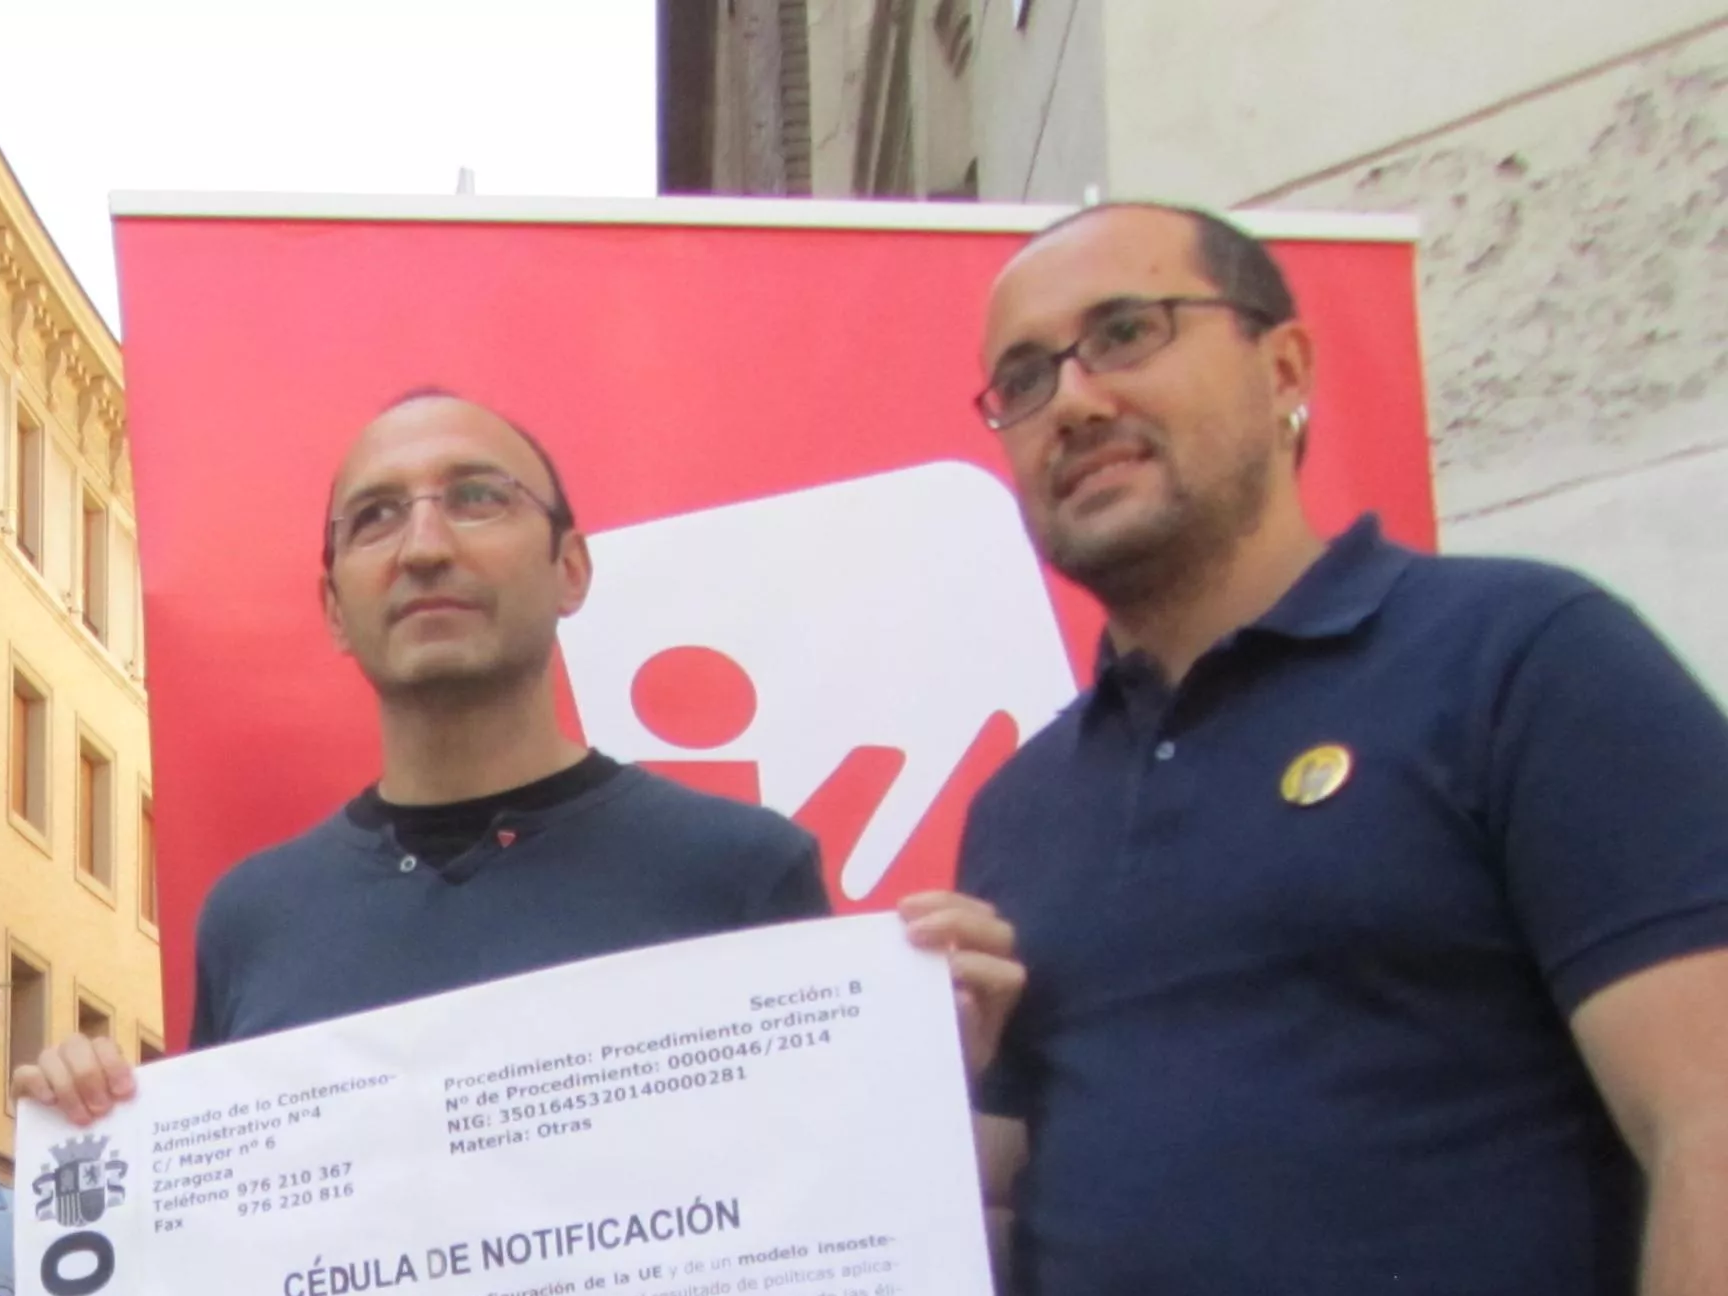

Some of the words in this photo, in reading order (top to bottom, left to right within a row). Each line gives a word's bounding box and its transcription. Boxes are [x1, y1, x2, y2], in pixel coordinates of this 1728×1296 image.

[848, 979, 862, 994] B
[600, 1022, 754, 1059] Procedimiento
[759, 1005, 860, 1031] ordinario
[474, 1090, 501, 1106] de
[666, 1029, 832, 1069] 0000046/2014
[151, 1109, 222, 1135] Juzgado
[226, 1103, 250, 1117] de
[254, 1099, 272, 1112] lo
[152, 1117, 280, 1152] Administrativo
[536, 1118, 592, 1138] Otras
[152, 1157, 172, 1173] C/
[177, 1147, 236, 1166] Mayor
[263, 1135, 277, 1149] 6
[152, 1168, 233, 1193] Zaragoza
[152, 1189, 230, 1211] Teléfono
[236, 1177, 272, 1196] 976
[278, 1169, 312, 1189] 210
[318, 1161, 352, 1180] 367
[152, 1218, 186, 1233] Fax
[236, 1197, 272, 1216] 976
[278, 1189, 313, 1209] 220
[318, 1182, 354, 1201] 816
[428, 1242, 470, 1278] DE
[481, 1197, 739, 1268] NOTIFICACIÓN
[583, 1275, 606, 1290] de
[612, 1271, 631, 1284] la
[637, 1265, 663, 1281] UE
[668, 1265, 678, 1280] y
[683, 1259, 705, 1275] de
[710, 1256, 732, 1270] un
[736, 1244, 809, 1265] modelo
